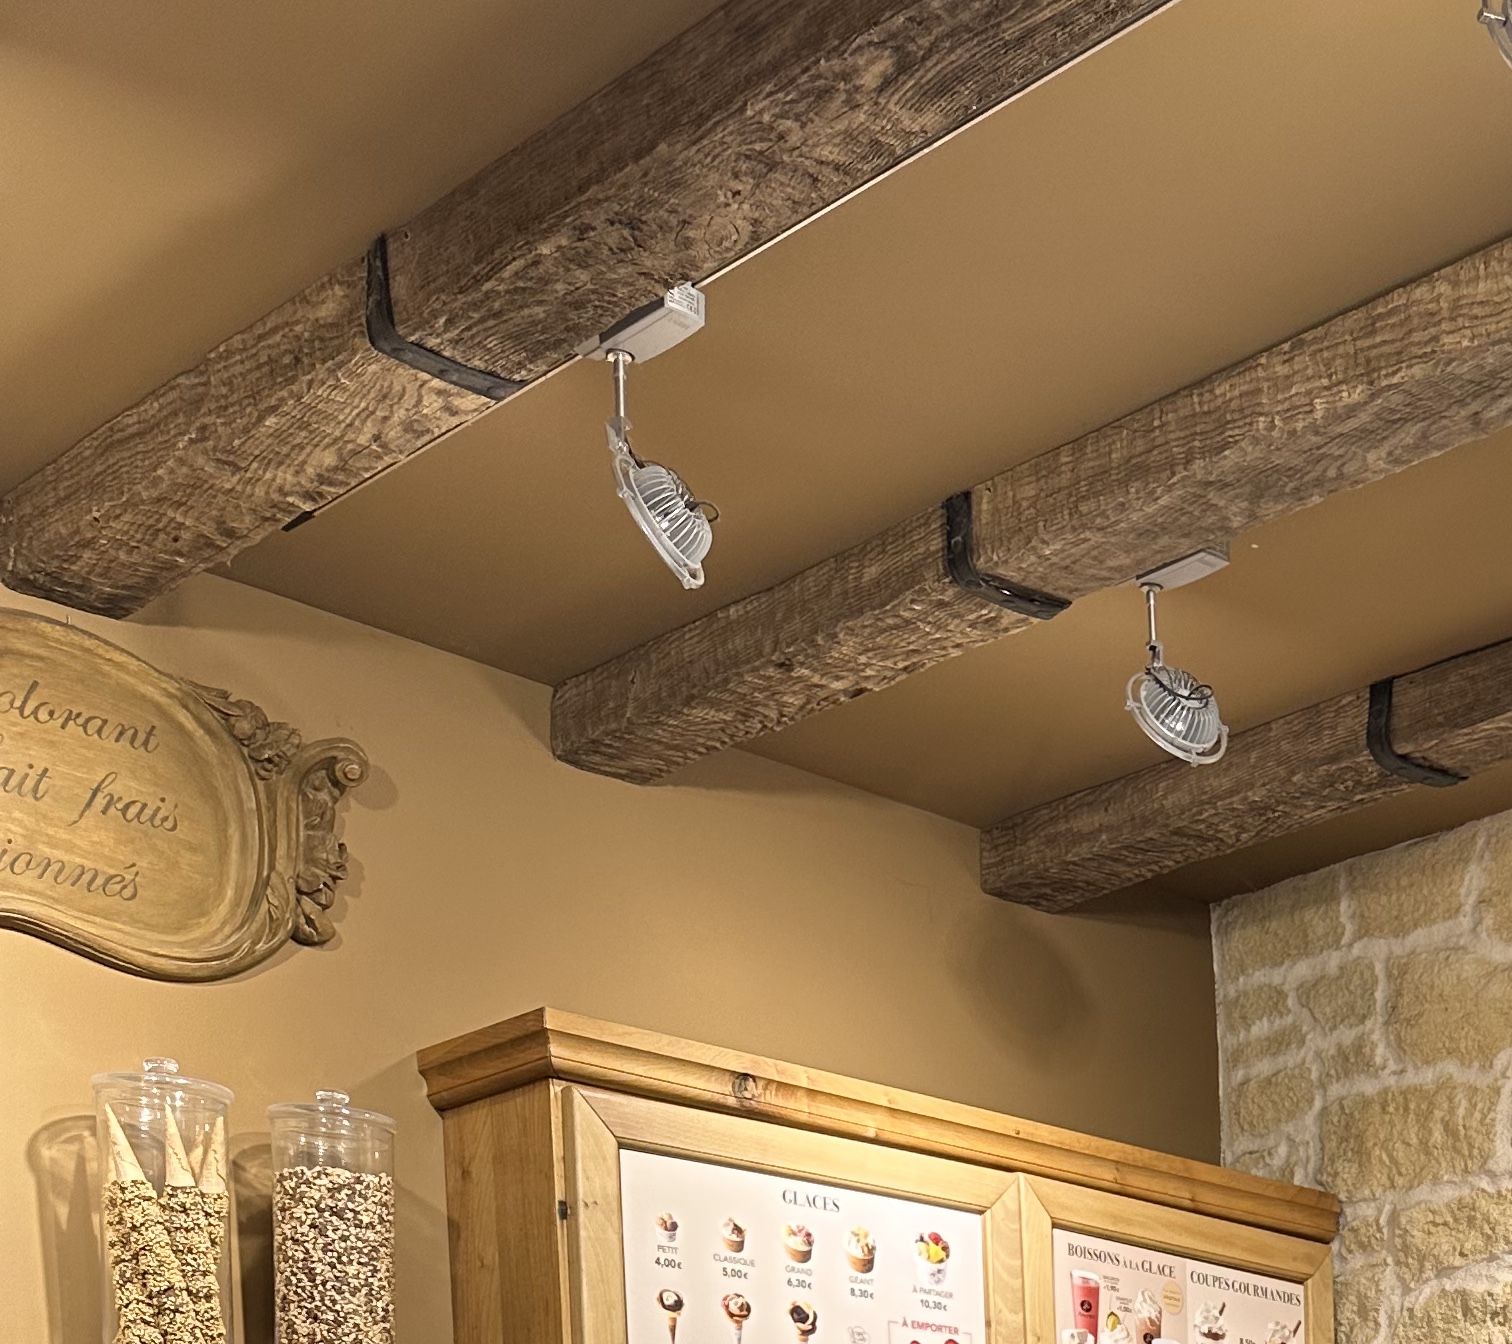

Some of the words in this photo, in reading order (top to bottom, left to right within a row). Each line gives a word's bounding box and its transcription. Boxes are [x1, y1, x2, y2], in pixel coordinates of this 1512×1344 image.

[67, 772, 178, 833] frais
[783, 1189, 840, 1212] GLACES
[657, 1245, 679, 1255] PETIT
[655, 1257, 682, 1270] 4,00€
[713, 1253, 756, 1267] CLASSIQUE
[1067, 1243, 1120, 1266] BOISSONS
[1123, 1256, 1127, 1268] À
[1129, 1260, 1140, 1272] LA
[1141, 1260, 1176, 1279] GLACE
[785, 1265, 812, 1277] GRAND
[912, 1284, 918, 1294] À
[919, 1287, 953, 1299] PARTAGER
[1190, 1270, 1231, 1291] COUPES
[1231, 1280, 1302, 1306] GOURMANDES
[902, 1316, 909, 1328] À
[911, 1320, 959, 1336] EMPORTER
